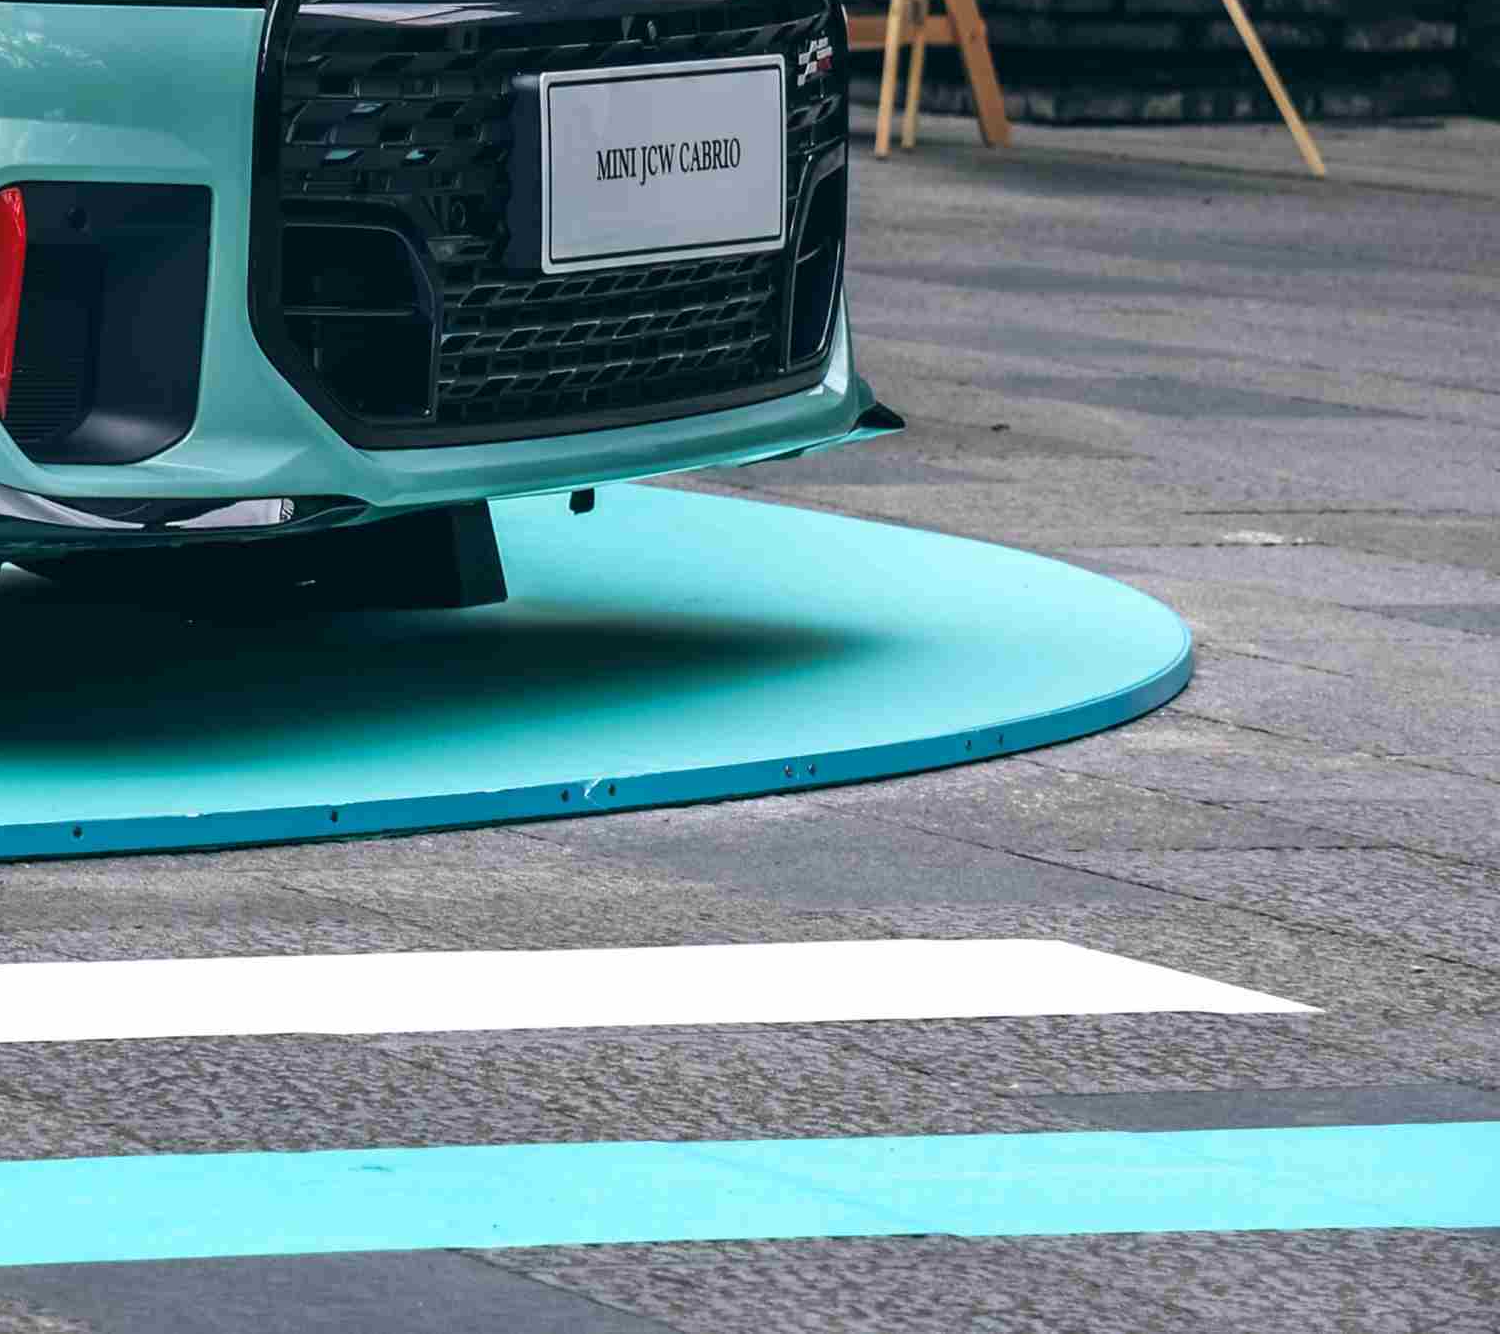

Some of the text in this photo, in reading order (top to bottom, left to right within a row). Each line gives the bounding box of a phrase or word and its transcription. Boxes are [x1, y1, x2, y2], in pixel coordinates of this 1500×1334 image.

[596, 137, 741, 186] MINI JCW CABRIO
